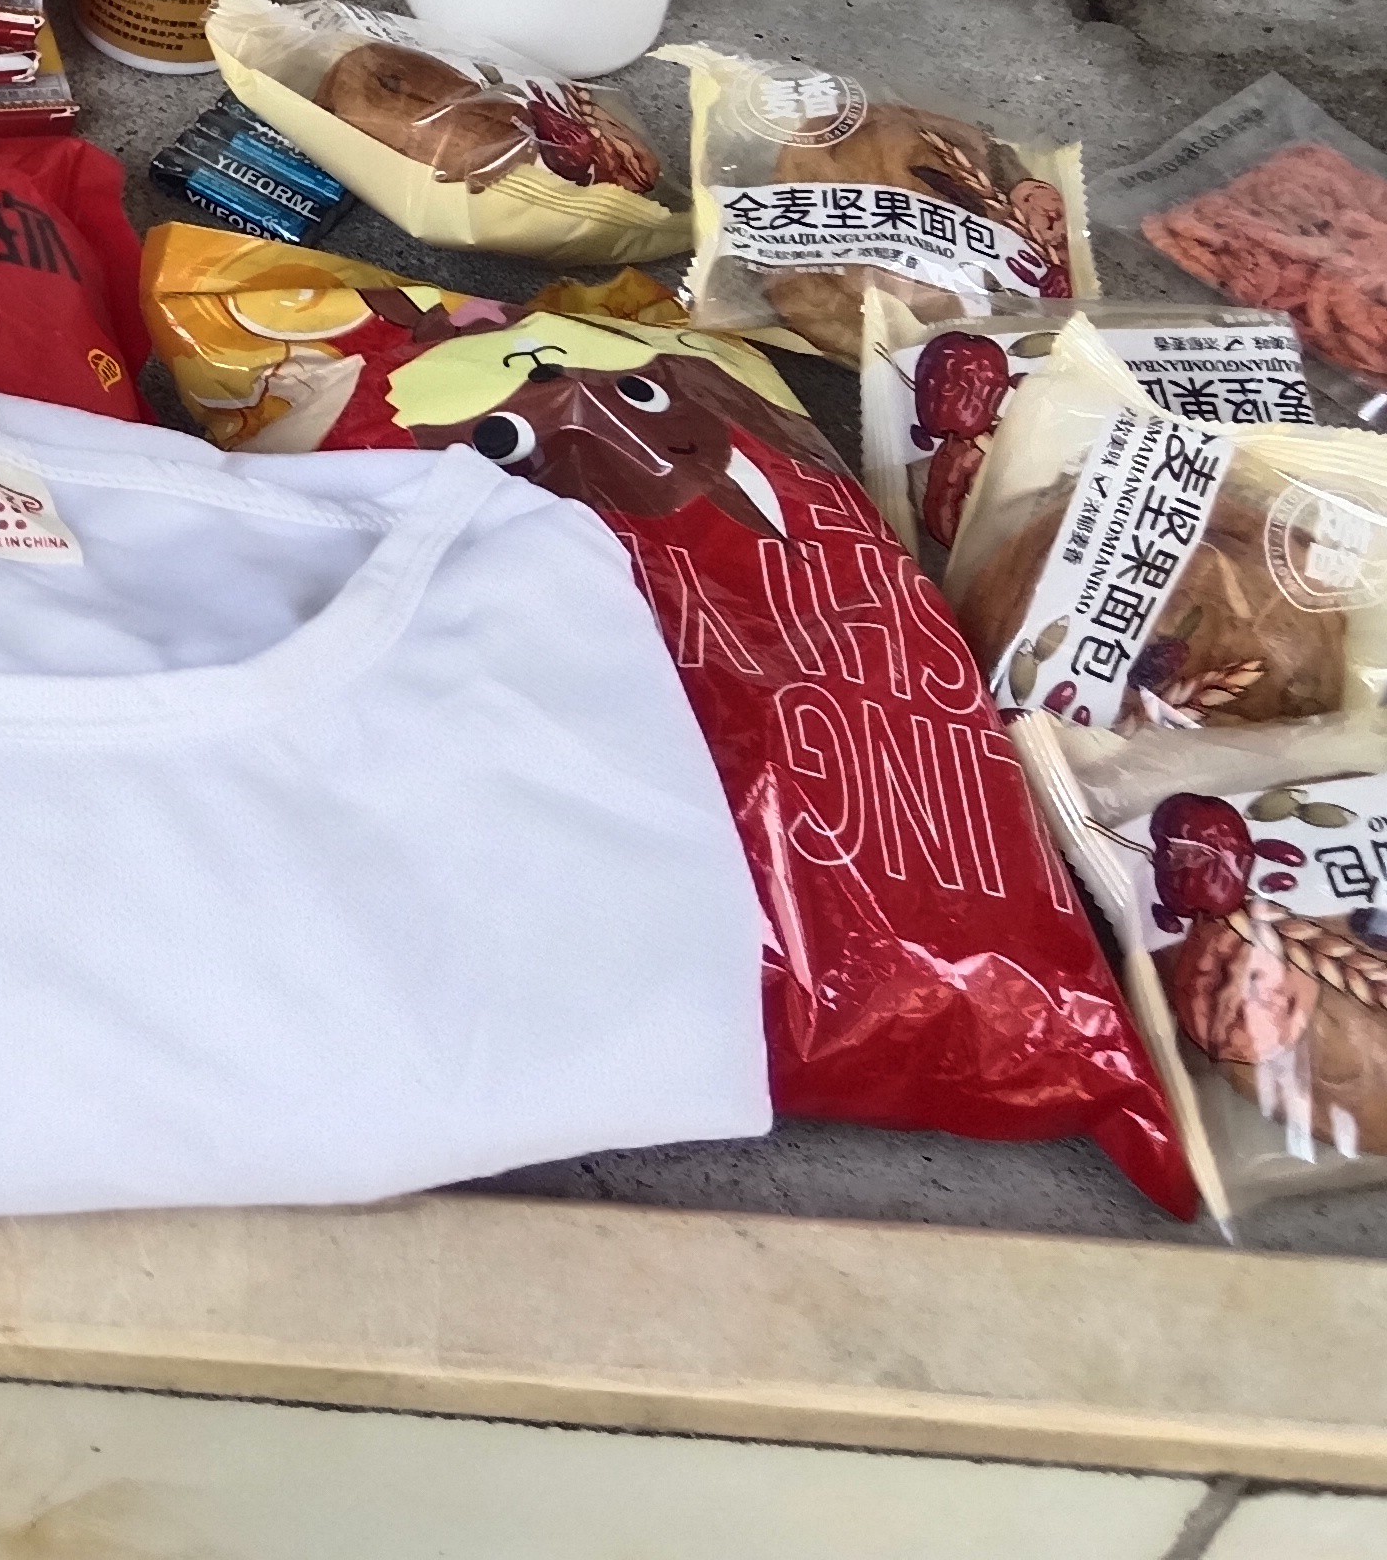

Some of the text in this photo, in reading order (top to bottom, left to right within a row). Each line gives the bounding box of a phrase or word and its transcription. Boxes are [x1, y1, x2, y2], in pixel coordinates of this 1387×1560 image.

[722, 185, 1001, 261] 全麦坚果面包
[4, 535, 21, 548] IN
[22, 535, 70, 550] CHINA
[1070, 421, 1222, 684] 麦坚果面包
[1314, 837, 1387, 904] 包
